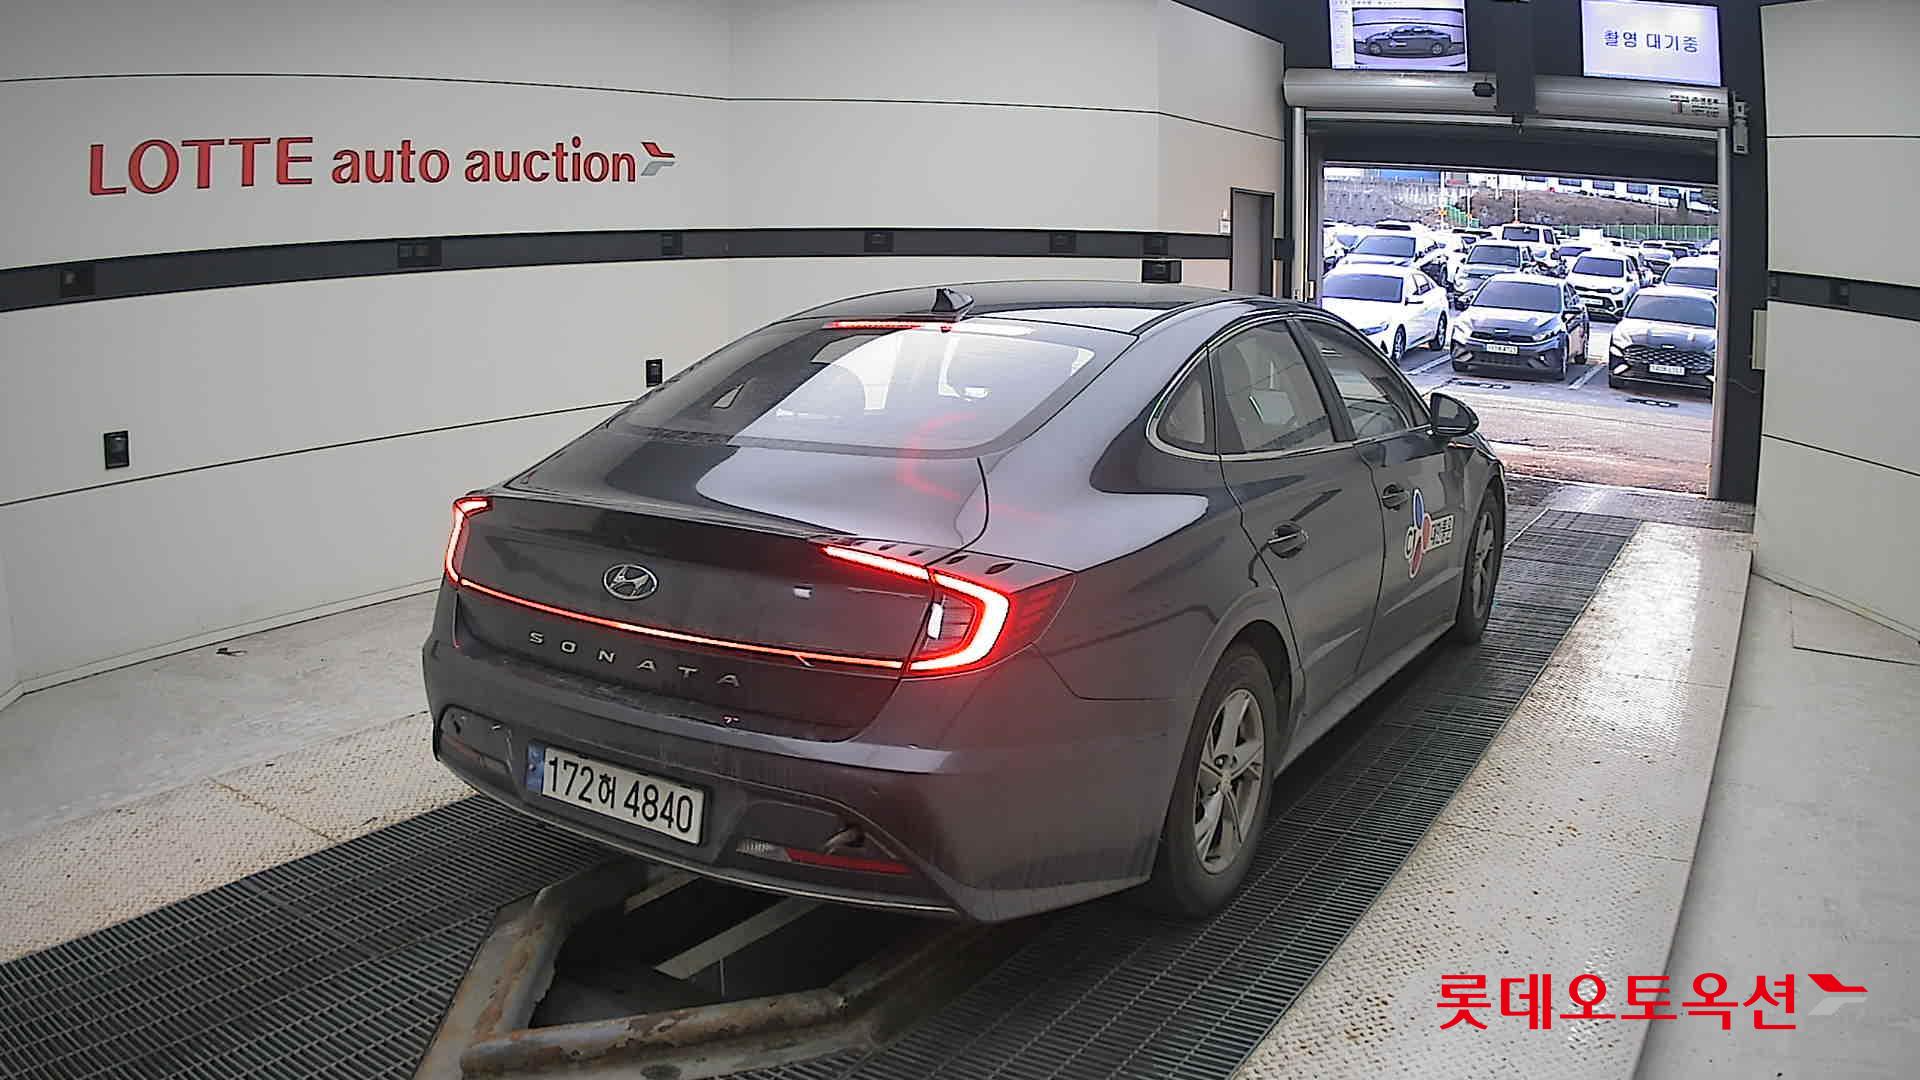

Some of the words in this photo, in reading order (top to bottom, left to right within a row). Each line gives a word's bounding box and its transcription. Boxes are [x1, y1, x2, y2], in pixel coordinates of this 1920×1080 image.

[1646, 33, 1698, 53] 대기중
[89, 136, 313, 196] LOTTE
[331, 139, 450, 184] auto
[464, 135, 637, 183] auction
[529, 631, 741, 687] SONATA
[549, 756, 617, 809] 172허
[624, 780, 694, 834] 4840
